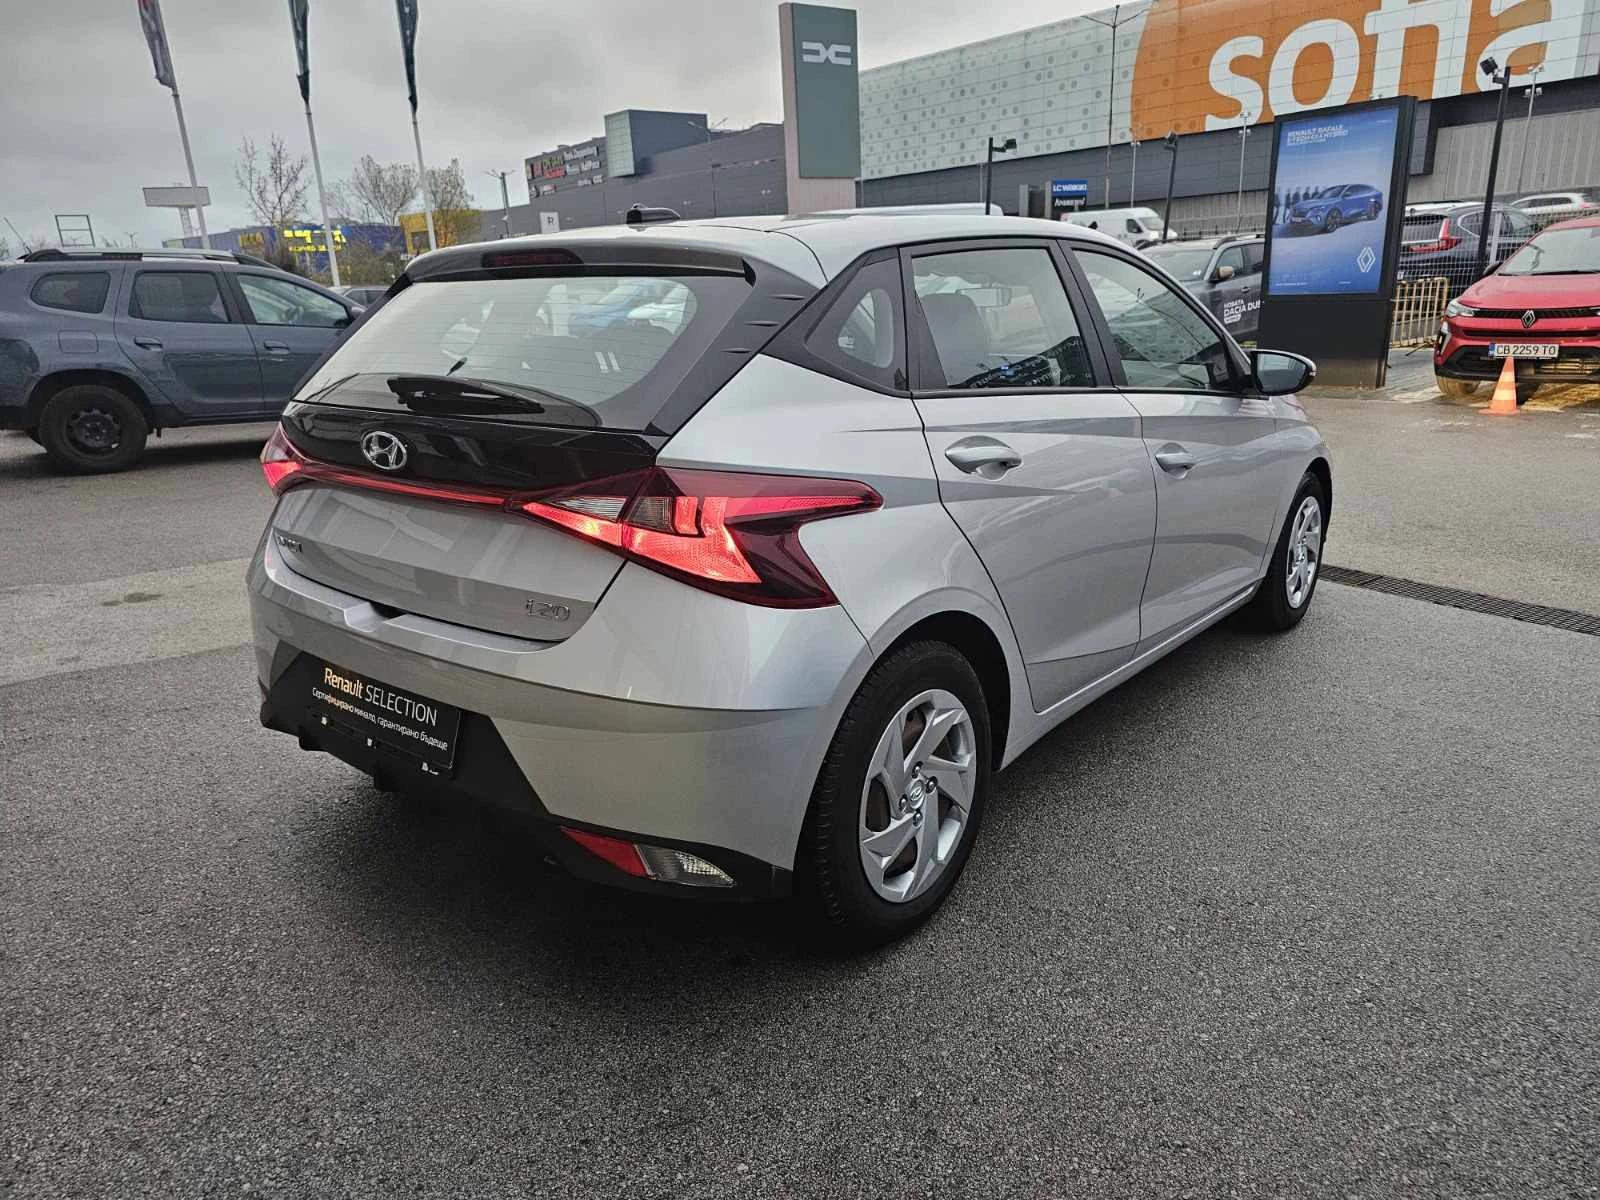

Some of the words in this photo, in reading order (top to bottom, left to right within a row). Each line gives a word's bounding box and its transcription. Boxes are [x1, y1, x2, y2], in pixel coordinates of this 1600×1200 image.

[1205, 0, 1583, 131] sofia
[1223, 305, 1246, 317] DACIA
[1512, 345, 1539, 355] 2259
[312, 687, 355, 713] Сертифицирано
[354, 705, 377, 725] минало,
[377, 716, 420, 739] гарантирано
[420, 731, 448, 751] бъдеще
[324, 667, 363, 698] Renault
[365, 684, 437, 726] SELECTION
